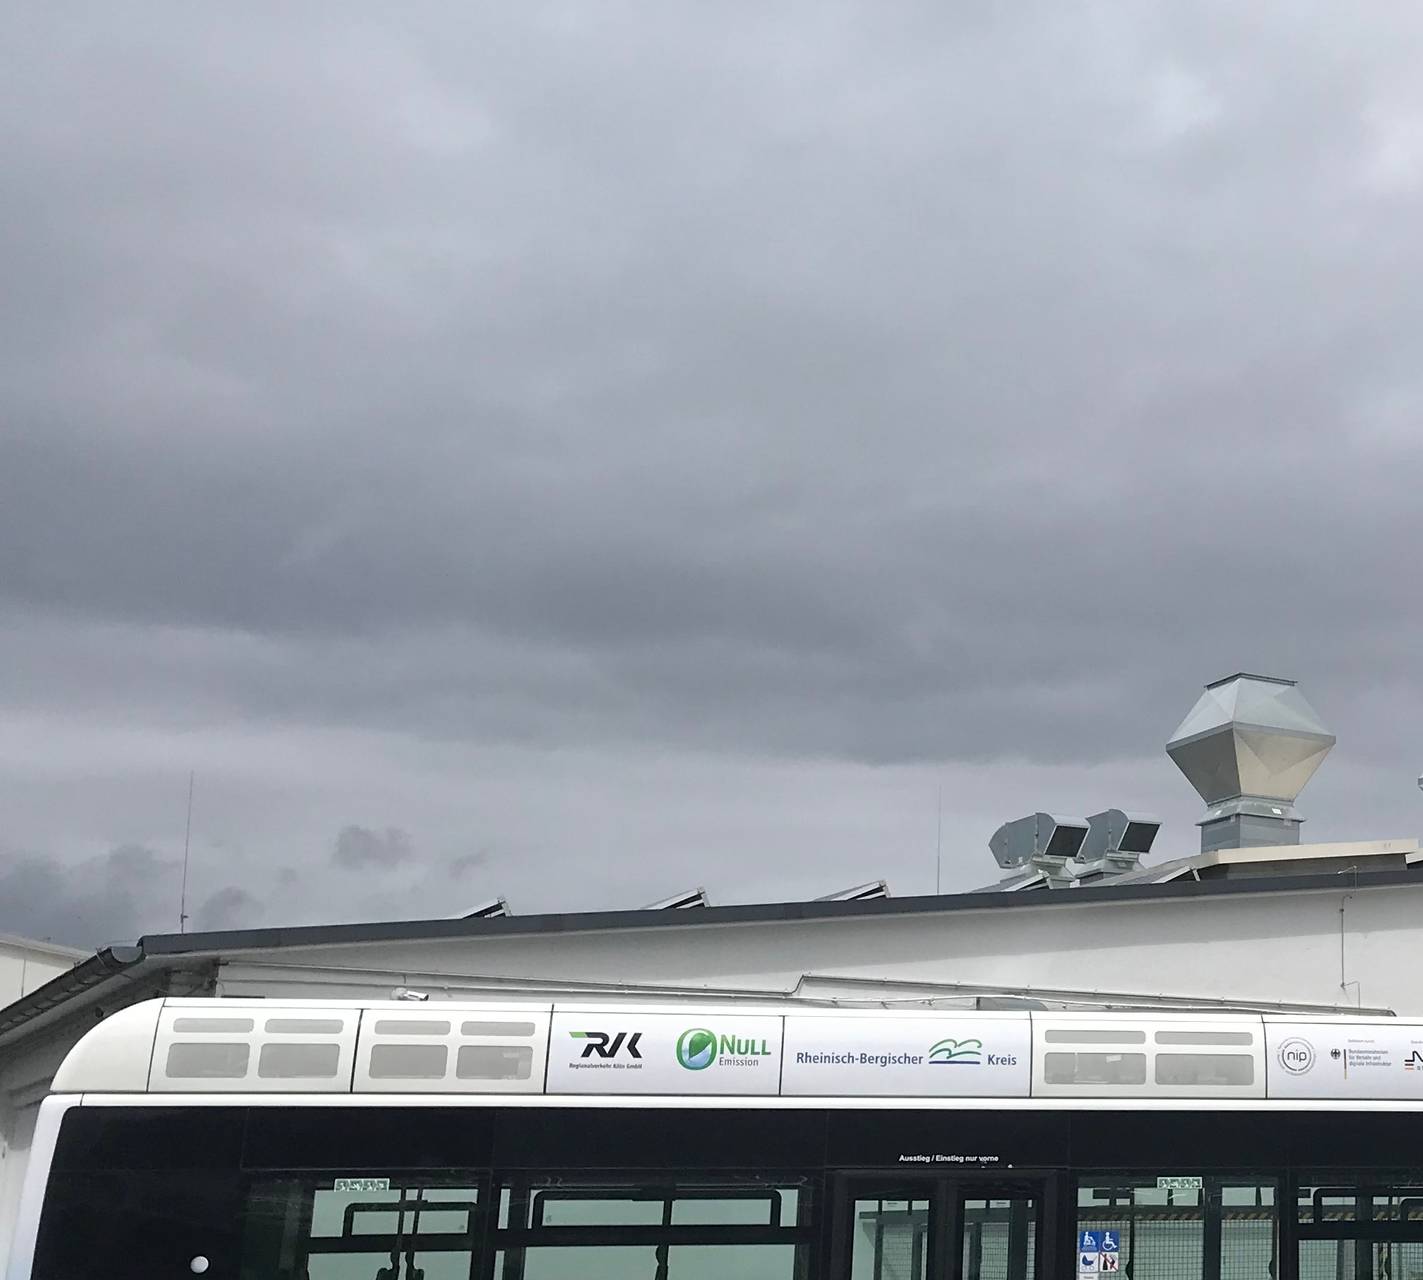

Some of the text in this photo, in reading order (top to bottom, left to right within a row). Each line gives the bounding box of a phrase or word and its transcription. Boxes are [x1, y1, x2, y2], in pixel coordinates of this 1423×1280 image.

[796, 1052, 1017, 1067] Rheinisch-Bergischer Kreis
[1287, 1048, 1307, 1063] nip
[719, 1057, 759, 1067] Emission
[899, 1154, 931, 1163] Ausstieg
[935, 1154, 964, 1163] Einstieg
